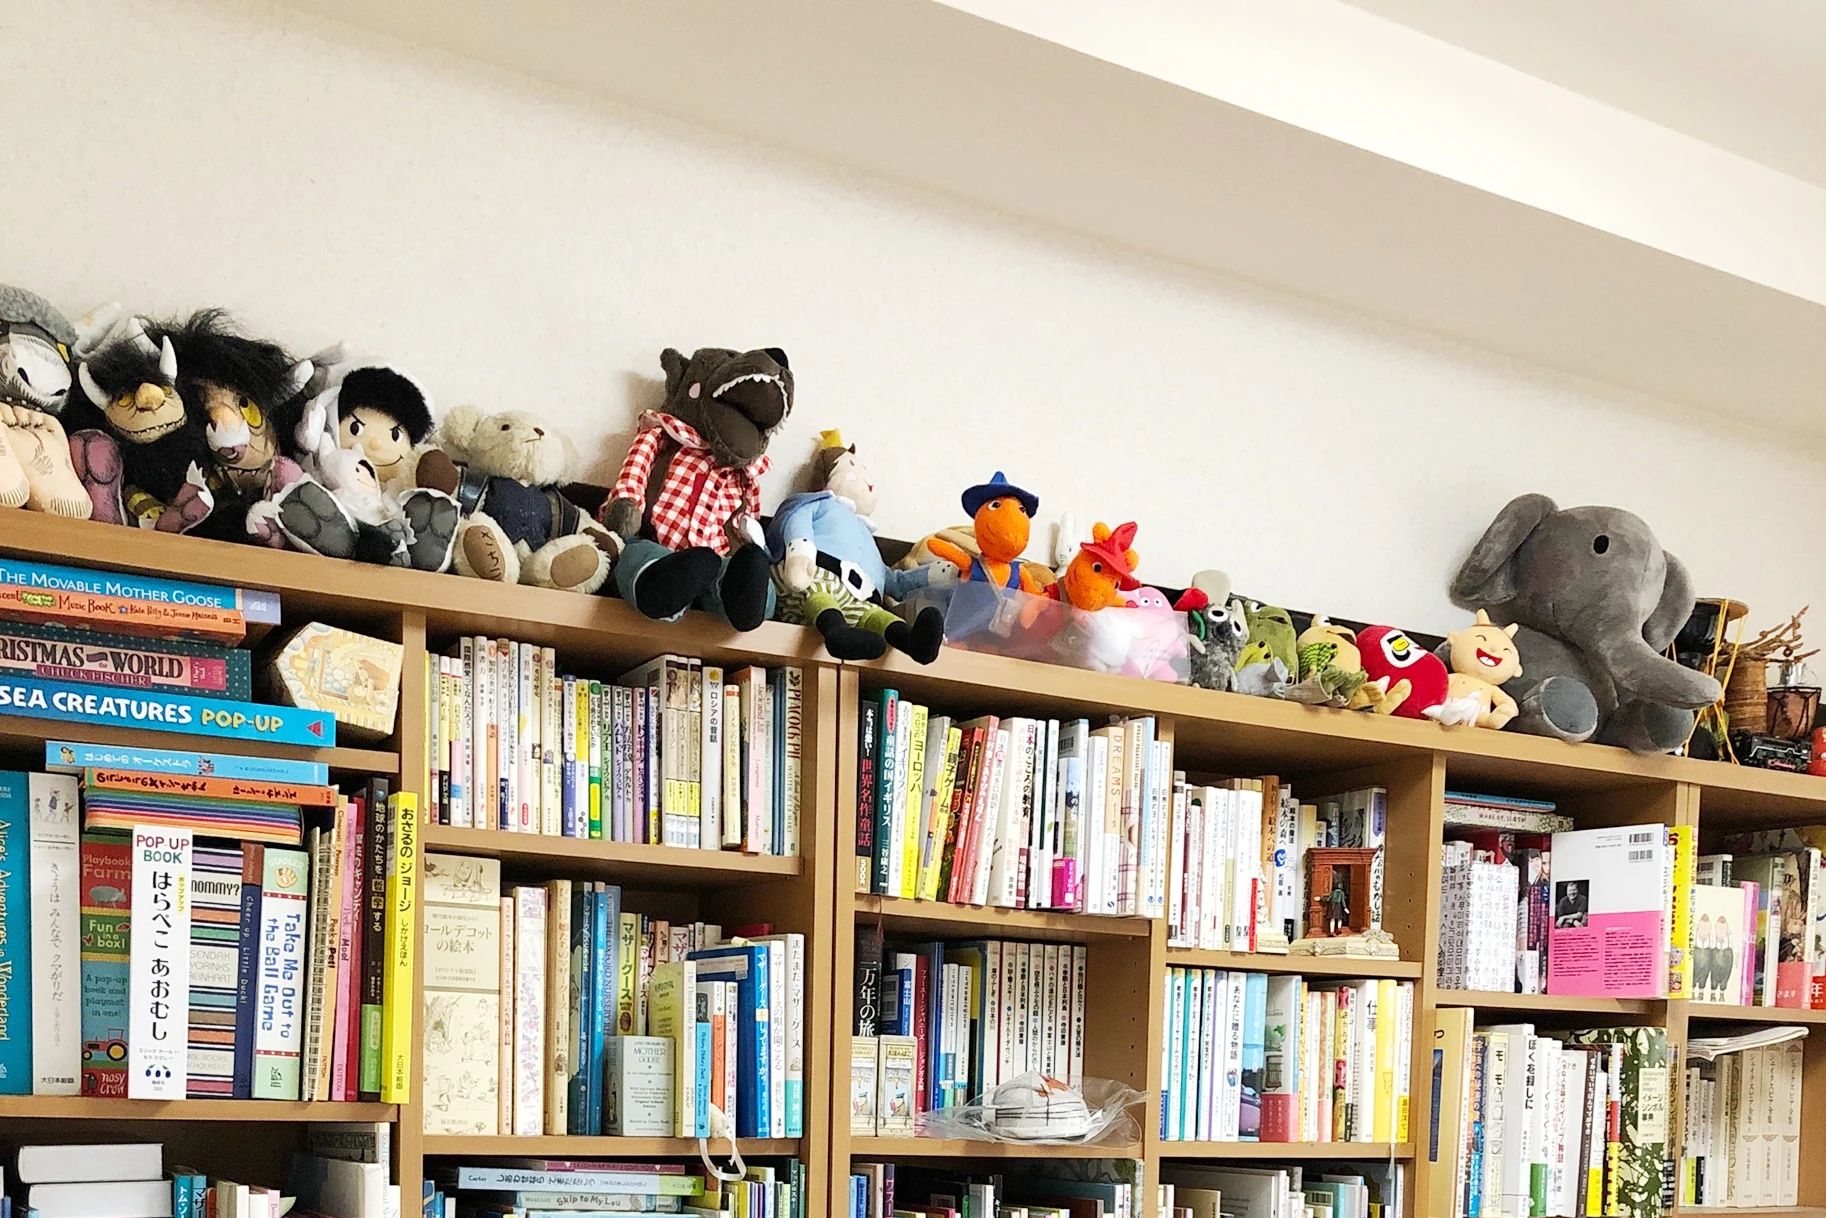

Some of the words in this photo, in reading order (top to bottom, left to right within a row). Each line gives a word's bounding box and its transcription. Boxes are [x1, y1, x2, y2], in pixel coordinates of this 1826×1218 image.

[32, 571, 101, 594] MOVABLE
[105, 581, 168, 601] MOTHER
[172, 591, 222, 609] GOOSE
[40, 665, 90, 682] CHUCK
[91, 671, 147, 686] FISCHER
[109, 654, 184, 679] WORLD
[0, 685, 48, 710] SEA
[52, 691, 193, 725] CREATURES
[201, 708, 284, 733] POP-UP
[709, 690, 720, 743] ロシアの昔話
[881, 734, 896, 828] 童話の国イギリス
[910, 741, 925, 793] ヨーロッパ
[1111, 734, 1123, 797] DREAMS
[857, 758, 874, 848] 世界名作童話
[399, 807, 415, 859] おさるの
[143, 851, 183, 864] BOOK
[399, 861, 414, 912] ジョージ
[89, 919, 113, 933] Fun
[152, 871, 173, 950] はらぺこ
[265, 918, 281, 941] the
[282, 913, 301, 953] Take
[264, 946, 279, 980] Ball
[436, 940, 475, 955] の絵本
[86, 974, 93, 983] A
[94, 975, 128, 985] pop-up
[281, 958, 299, 981] Me
[108, 985, 126, 995] and
[150, 958, 171, 1041] あおむし
[281, 990, 297, 1018] Out
[903, 979, 912, 1006] 富士山
[261, 984, 279, 1032] Game
[1230, 984, 1241, 1061] あなたに贈る物語
[1366, 999, 1379, 1031] 仕事
[280, 1022, 294, 1040] to
[633, 1047, 667, 1056] MOTHER
[100, 1072, 126, 1087] nosy
[556, 1196, 579, 1207] Skip
[580, 1195, 590, 1203] to
[590, 1195, 604, 1207] My
[604, 1196, 622, 1207] Lou
